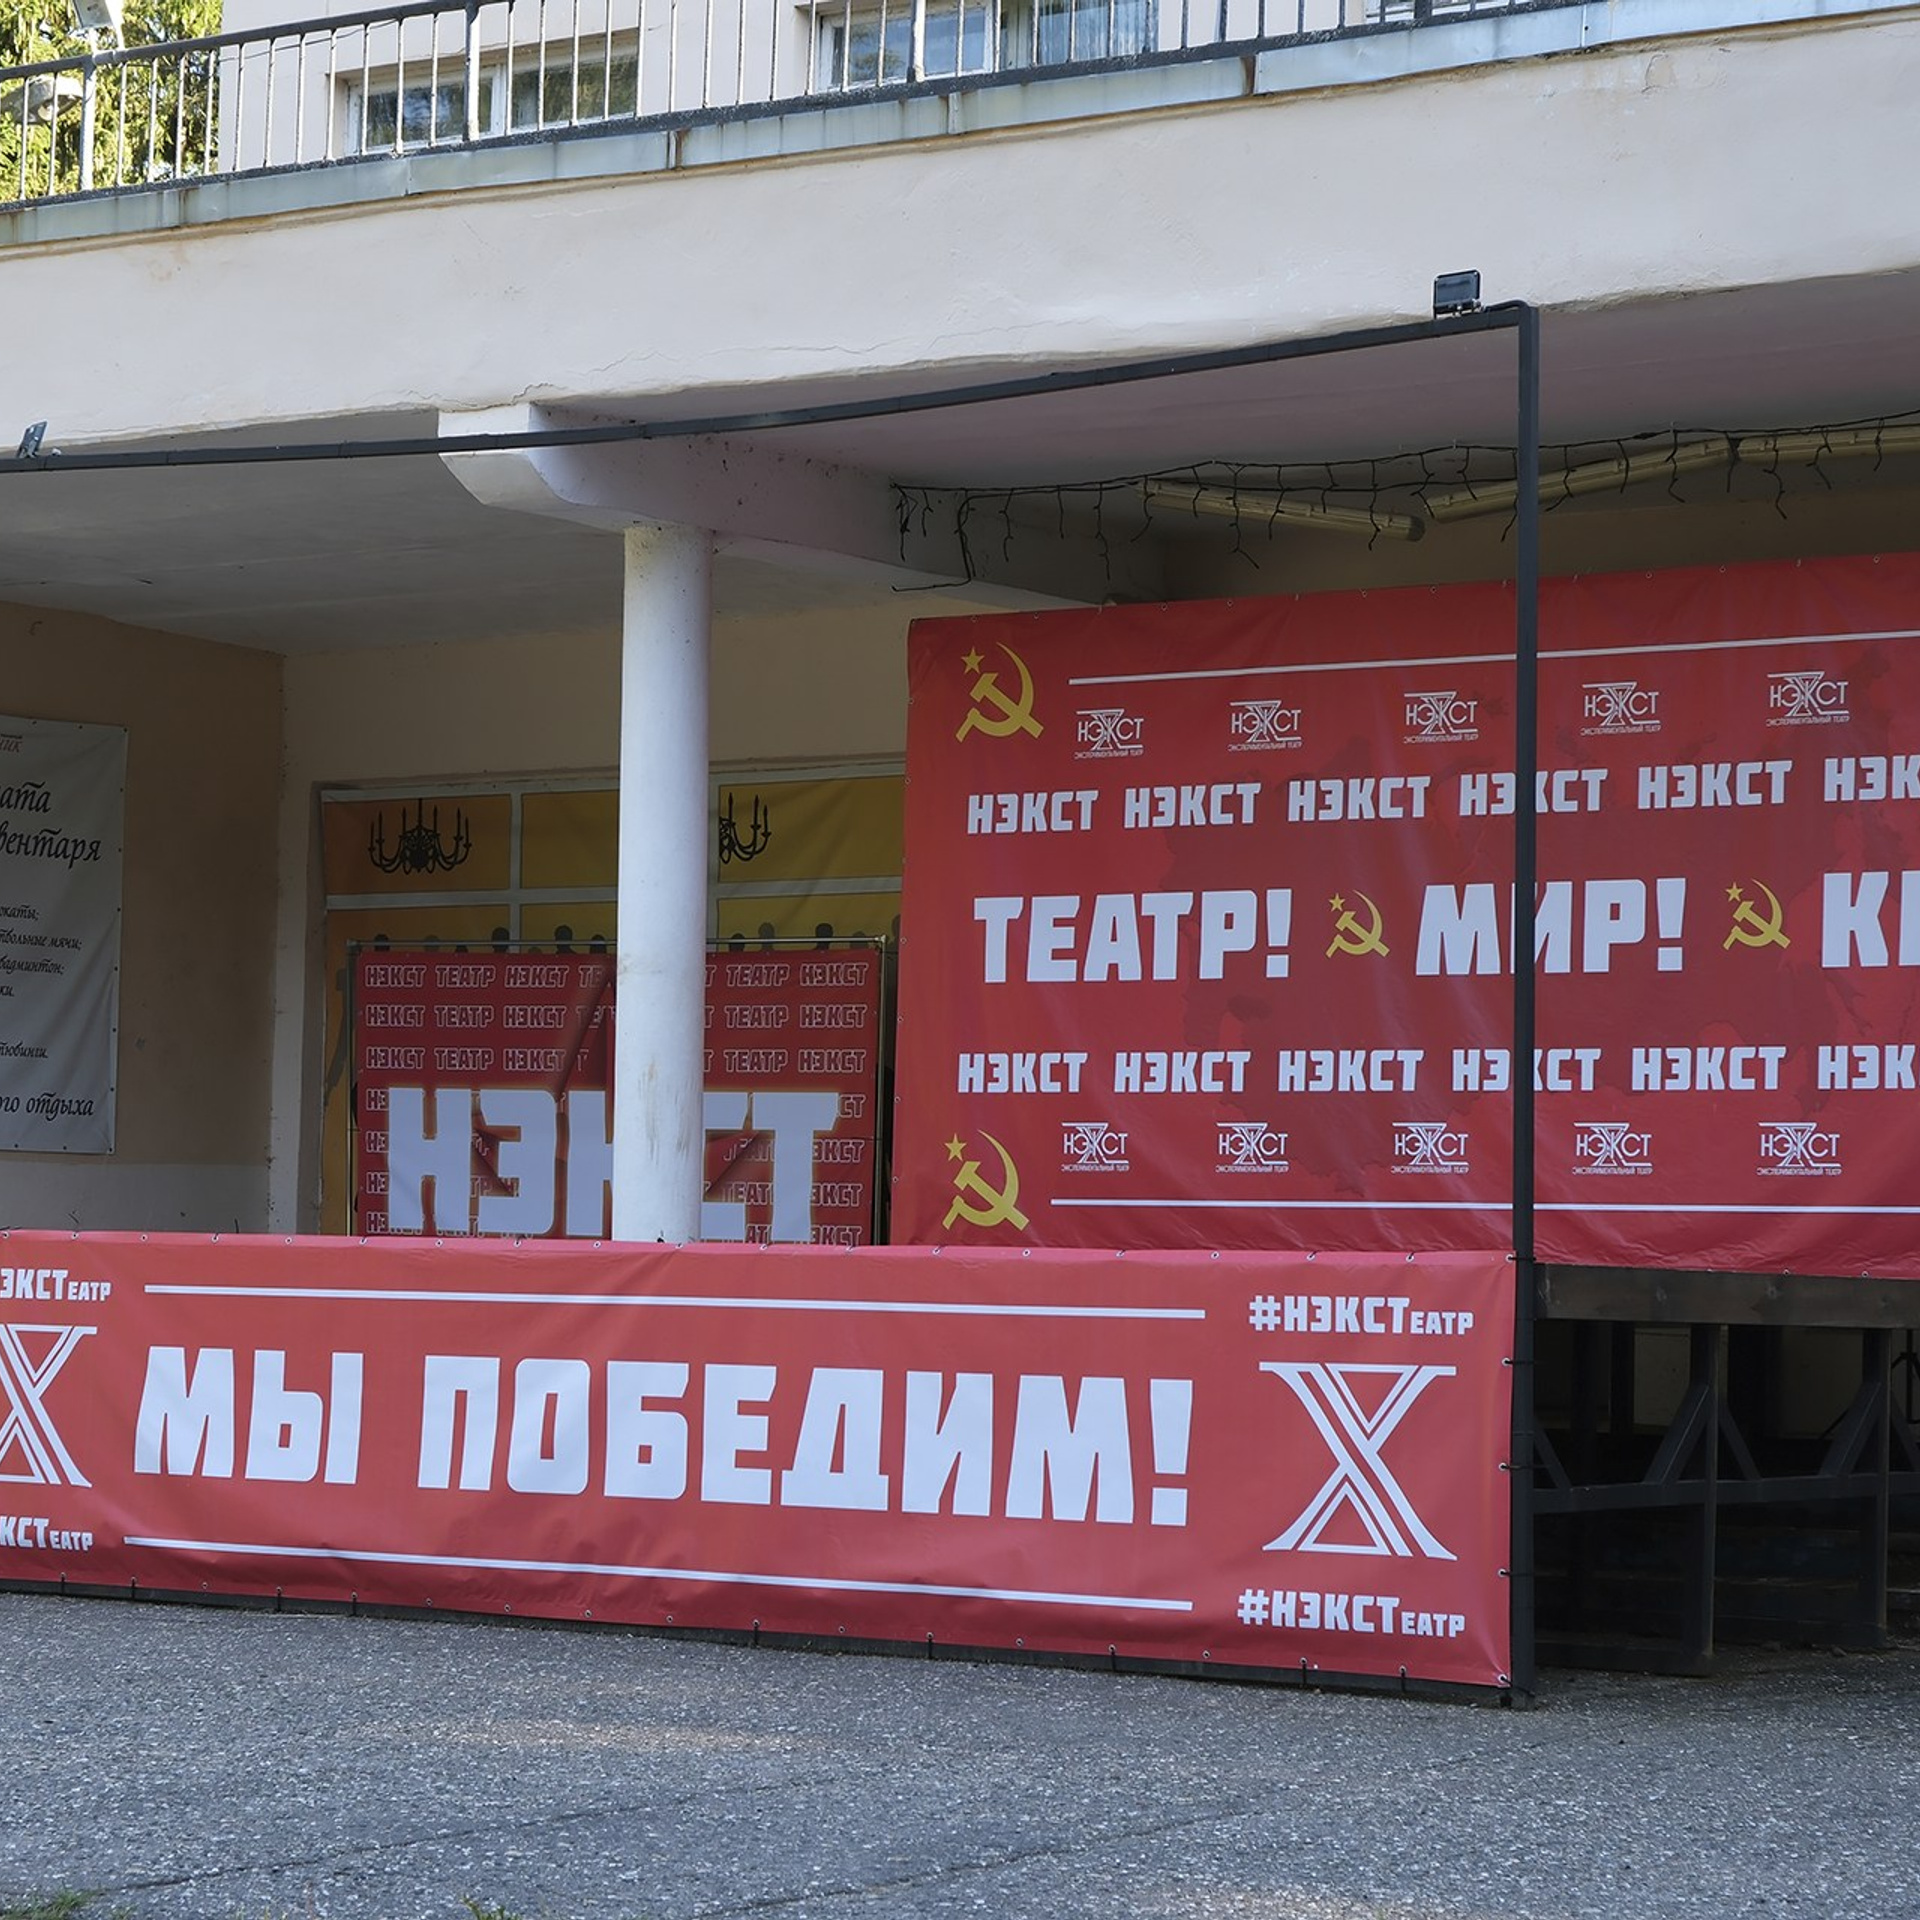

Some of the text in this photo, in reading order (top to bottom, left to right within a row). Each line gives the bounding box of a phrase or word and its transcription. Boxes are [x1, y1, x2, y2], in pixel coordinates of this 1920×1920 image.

[1584, 691, 1659, 717] НЭКСТ
[1770, 681, 1848, 708] НЭКСТ
[1231, 709, 1301, 734] НЭКСТ
[1406, 701, 1478, 725] НЭКСТ
[1078, 718, 1144, 742] НЭКСТ
[0, 781, 51, 813] ата
[968, 791, 1098, 833] НЭКСТ
[1125, 783, 1261, 828] НЭКСТ
[1289, 776, 1430, 821] НЭКСТ
[1638, 761, 1792, 809] НЭКСТ
[974, 889, 1291, 983] ТЕАТР!
[1416, 878, 1686, 975] МИР!
[366, 965, 427, 988] НЭКСТ
[435, 965, 496, 988] ТЕАТР
[505, 965, 569, 988] НЭКСТ
[727, 963, 790, 987] ТЕАТР
[800, 962, 868, 987] НЭКСТ
[366, 1005, 426, 1027] НЭКСТ
[434, 1005, 495, 1028] ТЕАТР
[503, 1005, 567, 1029] НЭКСТ
[724, 1004, 789, 1029] ТЕАТР
[800, 1003, 868, 1029] НЭКСТ
[366, 1047, 426, 1070] НЭКСТ
[434, 1047, 494, 1071] ТЕАТР
[503, 1048, 567, 1072] НЭКСТ
[723, 1048, 788, 1073] ТЕАТР
[798, 1049, 867, 1073] НЭКСТ
[958, 1053, 1087, 1093] НЭКСТ
[1114, 1051, 1251, 1092] НЭКСТ
[1279, 1050, 1424, 1091] НЭКСТ
[1632, 1047, 1786, 1090] НЭКСТ
[1818, 1045, 1920, 1089] НЭК
[0, 1092, 95, 1121] го отдыха
[812, 1138, 865, 1162] ЭКСТ
[1063, 1132, 1129, 1155] НЭКСТ
[1219, 1132, 1289, 1155] НЭКСТ
[1394, 1132, 1469, 1156] НЭКСТ
[1576, 1132, 1652, 1157] НЭКСТ
[1761, 1132, 1840, 1158] НЭКСТ
[724, 1182, 863, 1206] ТЕАТ ЭКСТ
[812, 1225, 863, 1246] ЭКСТ
[134, 1345, 1193, 1527] МЫ ПОБЕДИМ!
